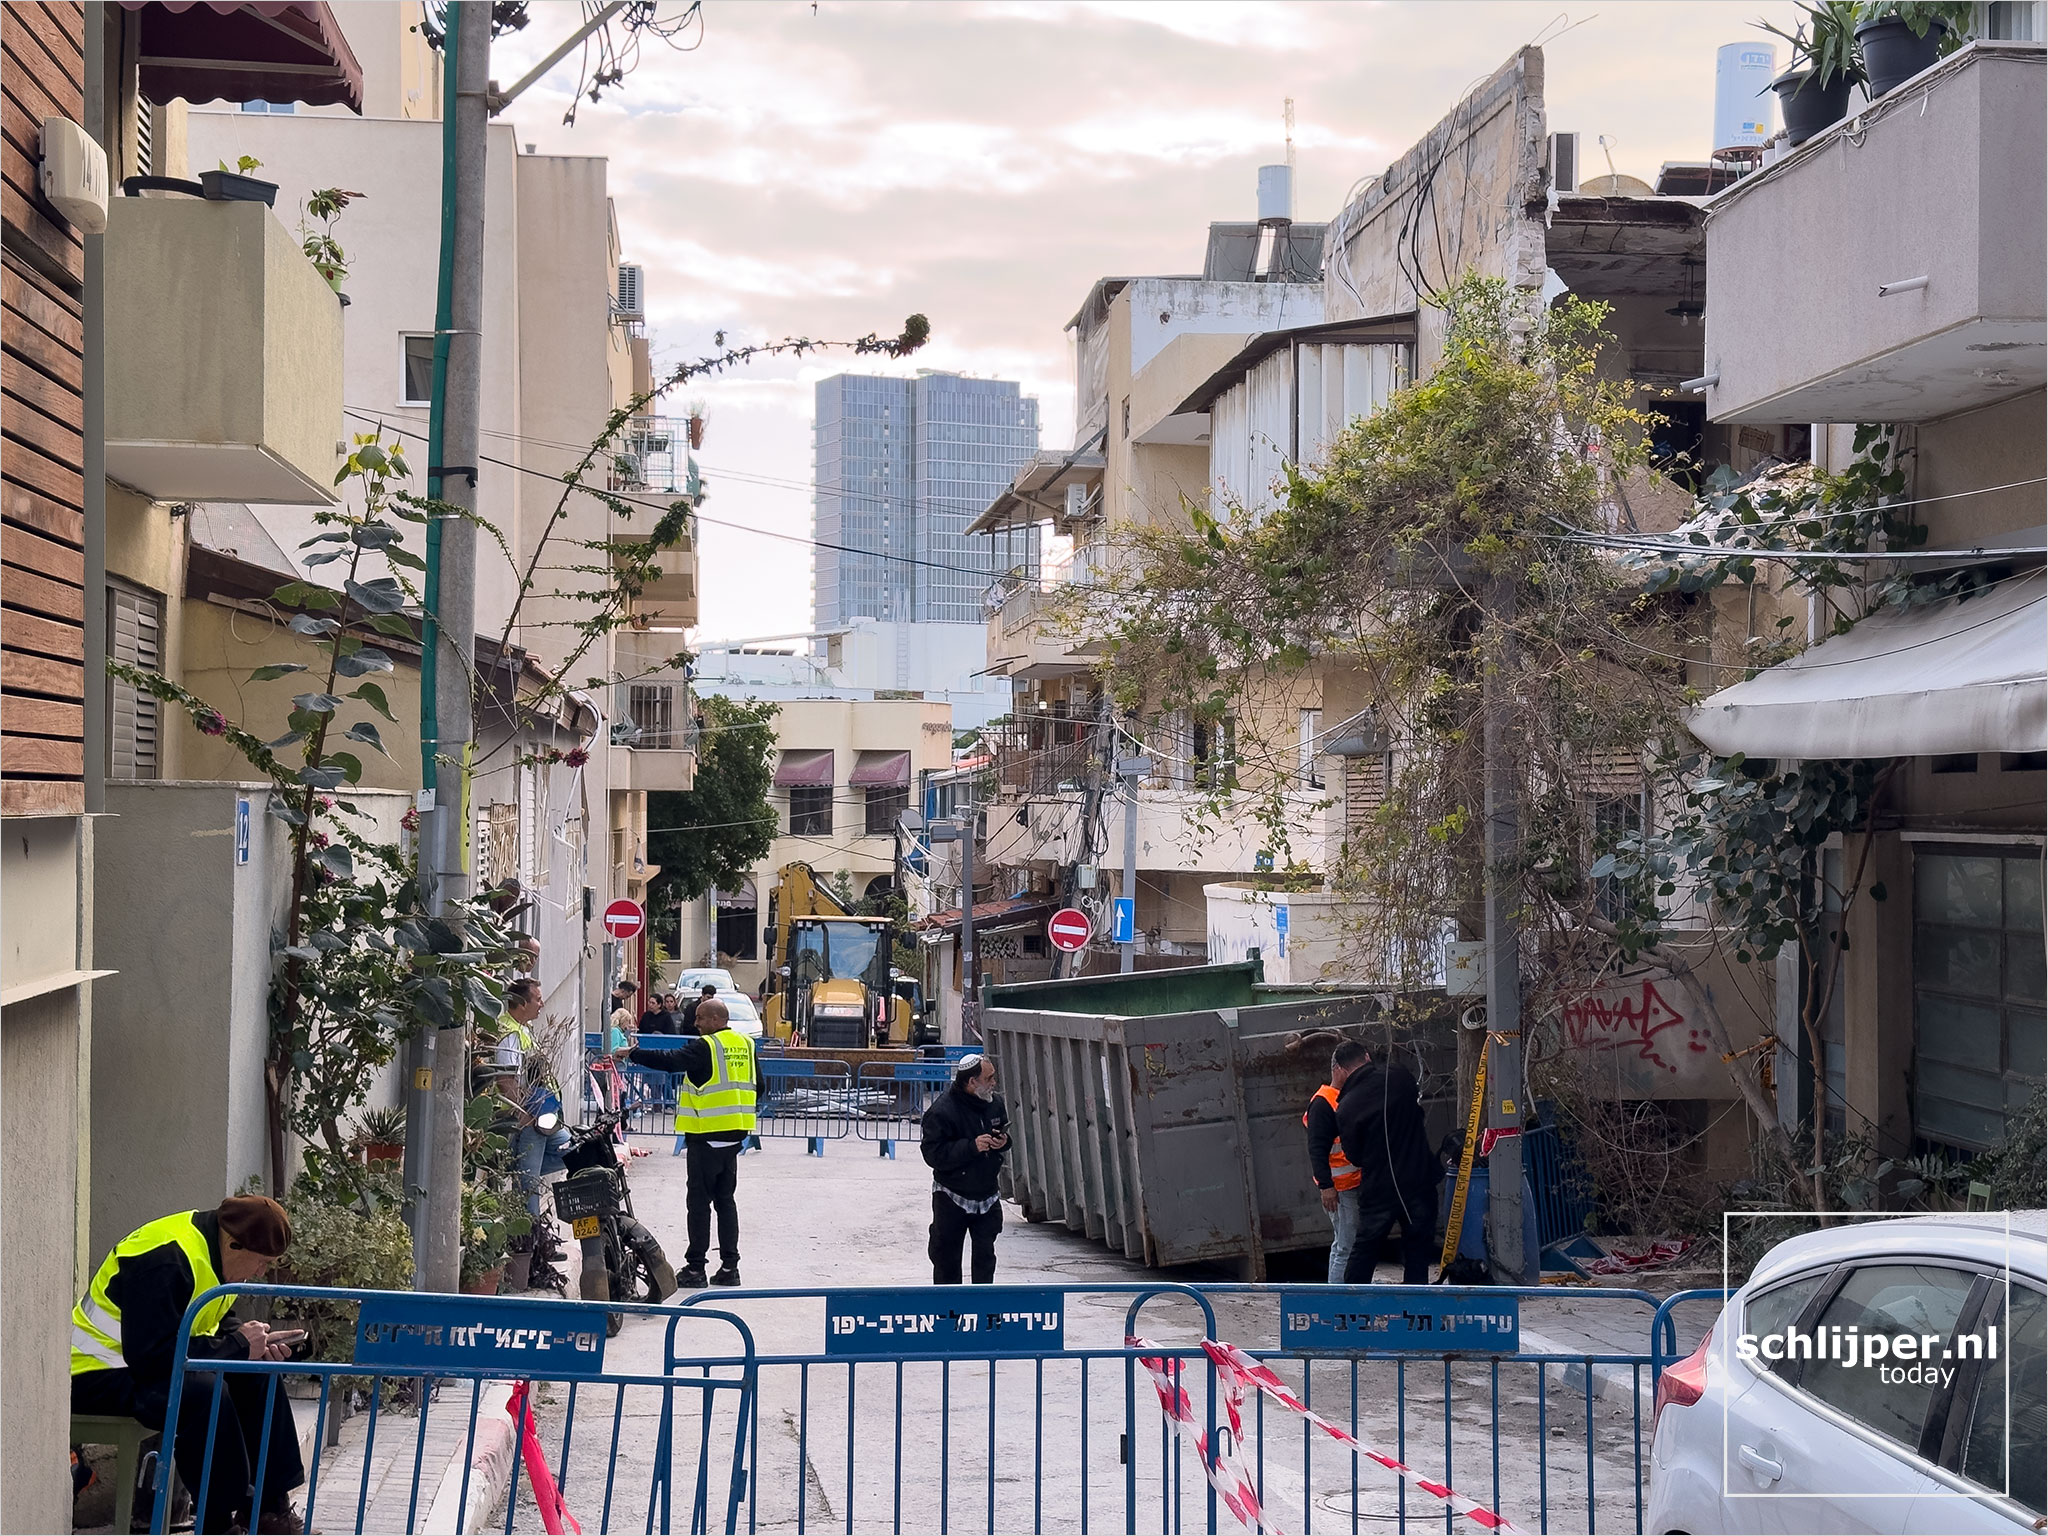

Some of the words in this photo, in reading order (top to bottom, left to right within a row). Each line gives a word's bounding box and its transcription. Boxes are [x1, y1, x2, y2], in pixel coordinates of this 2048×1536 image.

[239, 811, 248, 849] 12
[575, 1225, 598, 1237] 0249
[576, 1220, 589, 1229] AF
[984, 1311, 1059, 1332] עיריית
[1439, 1312, 1514, 1334] עיריית
